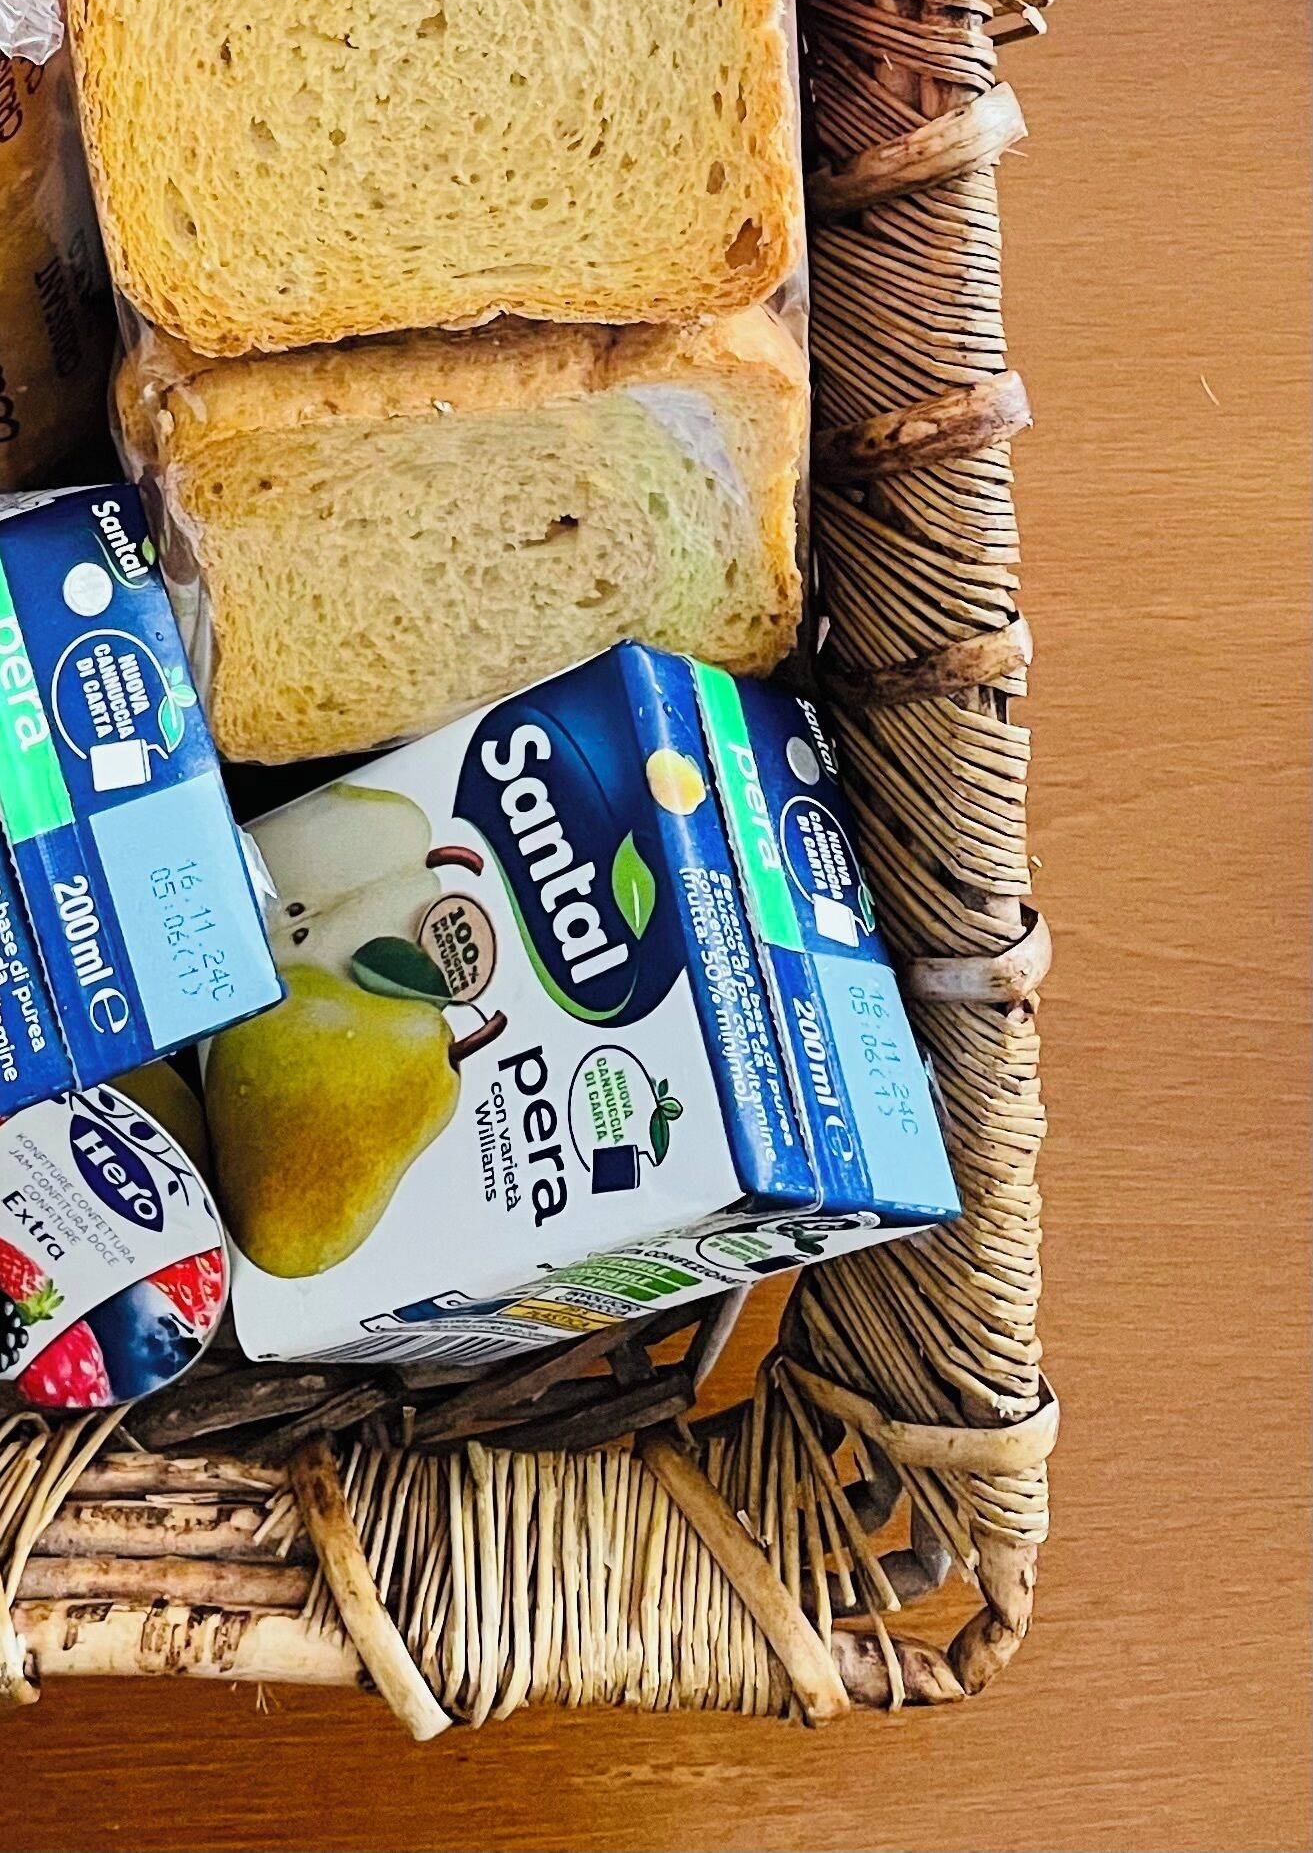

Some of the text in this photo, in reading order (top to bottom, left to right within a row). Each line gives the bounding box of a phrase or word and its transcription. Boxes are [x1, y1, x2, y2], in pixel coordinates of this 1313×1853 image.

[91, 500, 149, 579] Santal
[76, 657, 114, 739] DI CARTA
[93, 643, 136, 740] CANNUCCIA
[117, 653, 151, 716] NUOVA
[795, 697, 838, 775] Santal
[727, 744, 783, 871] pera
[481, 724, 629, 984] Santal
[796, 814, 828, 890] DI CARTA
[808, 810, 844, 900] CANNUCCIA
[826, 829, 852, 886] NUOVA
[53, 875, 114, 987] 200ml
[431, 921, 461, 996] NATURALE
[448, 906, 480, 984] 100%
[678, 867, 709, 946] (frutta:
[700, 948, 723, 1005] 50%
[713, 885, 737, 952] succo
[9, 959, 34, 990] di
[445, 933, 470, 990] ORIGINE
[13, 988, 46, 1053] purea
[719, 872, 750, 969] Bevanda
[750, 992, 769, 1047] base
[768, 1079, 794, 1147] purea
[614, 1068, 634, 1120] NUOVA
[732, 1012, 752, 1056] con
[744, 1058, 777, 1163] vitamine
[792, 996, 840, 1108] 200ml
[498, 1045, 568, 1228] pera
[584, 1070, 608, 1142] DI CARTA
[596, 1057, 625, 1144] CANNUCCIA
[72, 1130, 158, 1220] Hero
[475, 1099, 496, 1203] Williams
[491, 1081, 521, 1212] con varietà
[2, 1191, 66, 1261] Extra
[9, 1149, 119, 1267] JAM CONFITURA DOCE
[16, 1133, 136, 1265] KONFITURE CONFETTURA
[22, 1184, 81, 1246] CONFITURE
